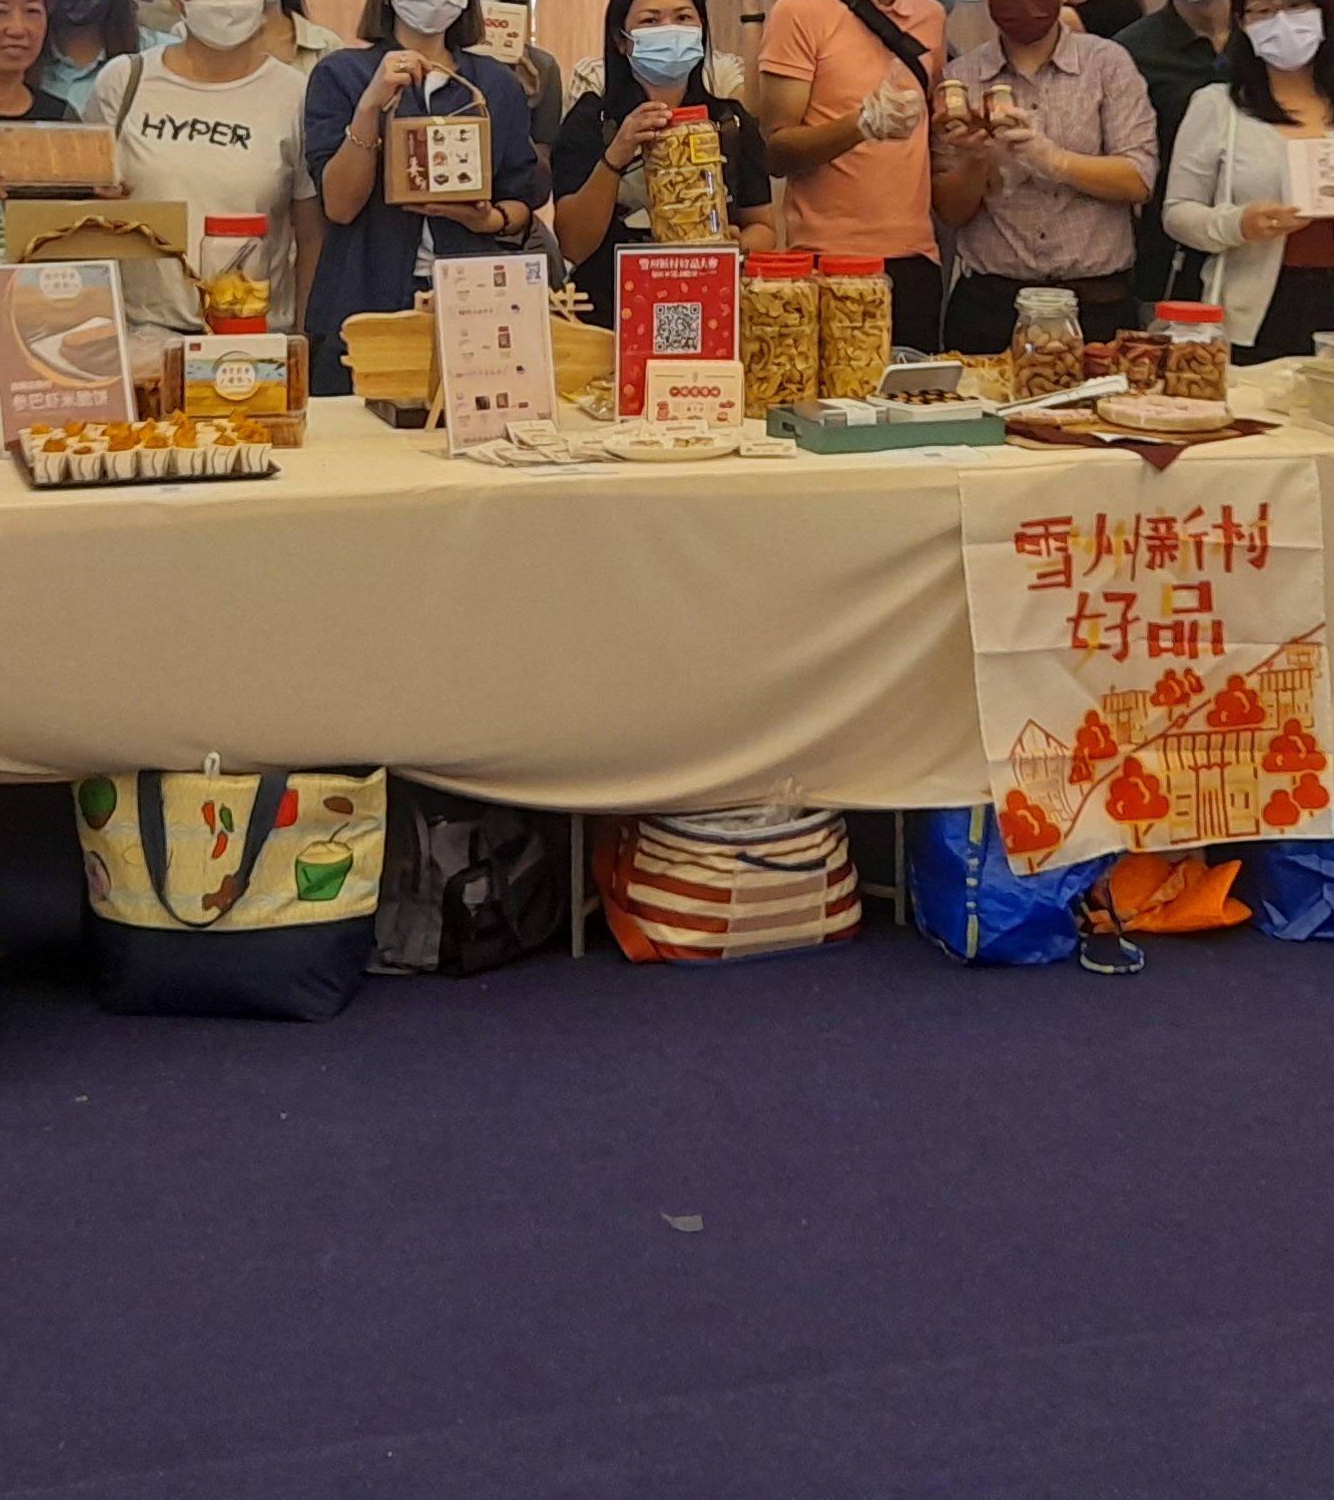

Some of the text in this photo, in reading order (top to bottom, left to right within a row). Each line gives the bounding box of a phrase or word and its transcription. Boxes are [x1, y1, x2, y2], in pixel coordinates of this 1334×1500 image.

[141, 112, 252, 151] HYPER
[1014, 502, 1271, 592] 雪州新村
[1066, 580, 1226, 676] 好品
